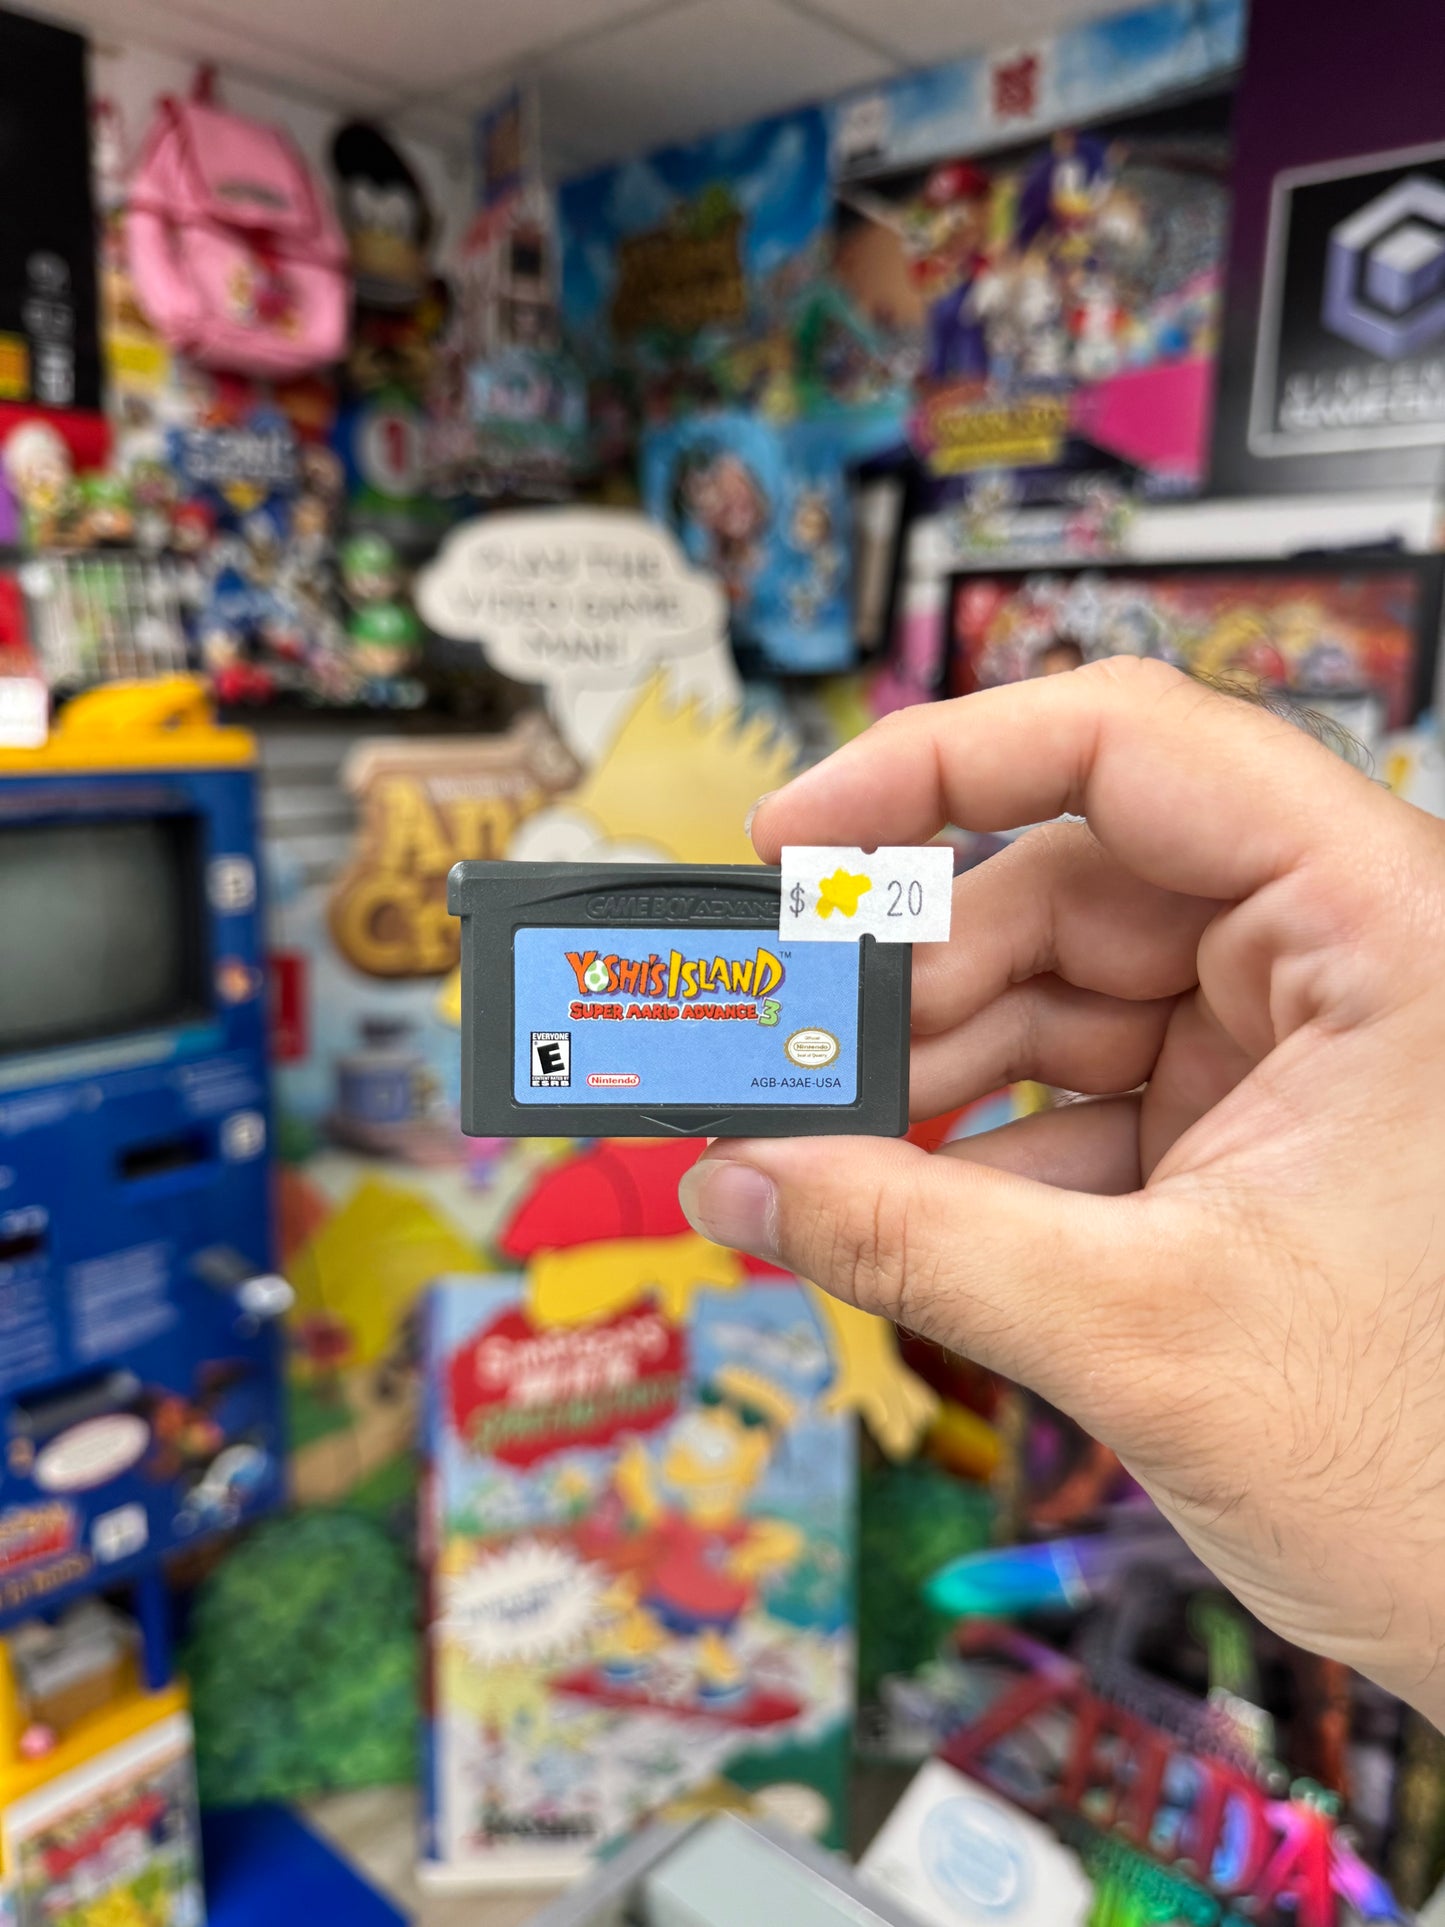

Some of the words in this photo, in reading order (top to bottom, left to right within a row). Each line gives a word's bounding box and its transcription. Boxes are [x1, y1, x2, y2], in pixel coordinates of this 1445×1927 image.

[585, 895, 651, 920] GAME
[653, 896, 694, 920] BOY
[692, 900, 779, 920] ADVANC
[789, 882, 805, 918] $
[886, 880, 922, 917] 20
[565, 950, 666, 996] YOSHI'S
[668, 947, 785, 999] ISLAND
[569, 1002, 624, 1020] SUPER
[625, 1003, 680, 1020] MARIO
[681, 1002, 758, 1020] ADVANCE
[758, 999, 782, 1027] 3
[532, 1032, 569, 1040] EVERYONE
[537, 1042, 565, 1075] E
[591, 1076, 638, 1084] Nintendo
[751, 1077, 842, 1088] AGB-A3AE-USA
